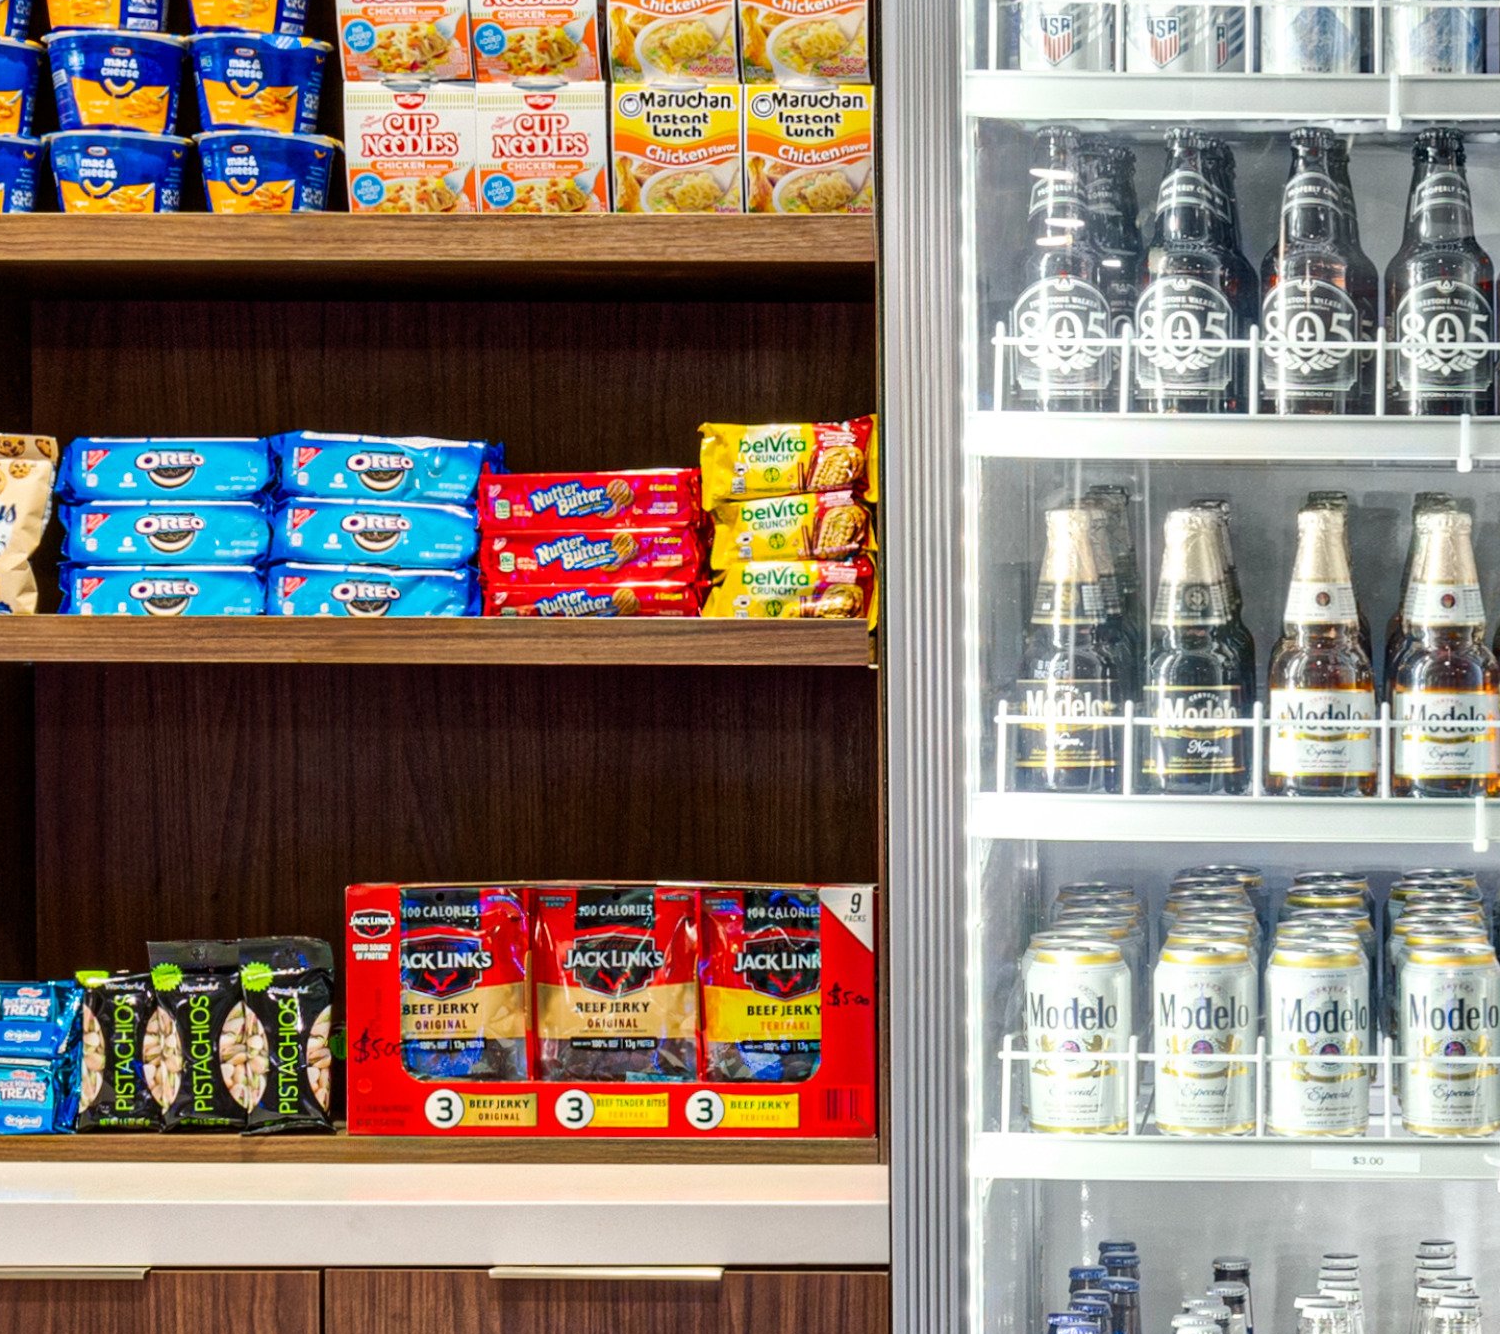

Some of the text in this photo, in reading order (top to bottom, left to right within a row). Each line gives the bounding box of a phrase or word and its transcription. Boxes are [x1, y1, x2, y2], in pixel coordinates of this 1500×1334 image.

[367, 7, 416, 16] CHICKEN
[1040, 17, 1072, 38] USA
[772, 92, 863, 108] Maruchan
[383, 114, 438, 134] CUP
[779, 112, 841, 124] Instant
[785, 125, 835, 138] Lunch
[362, 133, 458, 157] NOODLES
[1264, 312, 1353, 358] 805
[739, 432, 806, 454] belVita
[136, 451, 204, 471] OREO
[346, 453, 413, 473] OREO
[749, 453, 796, 463] CRUNCHY
[531, 483, 579, 511] Nutter
[558, 486, 604, 512] Butter
[598, 904, 653, 917] CALORIES
[850, 893, 862, 914] 9
[844, 915, 866, 923] PACKS
[564, 950, 664, 969] JACK LINK'S
[4, 1005, 48, 1018] TREATS
[576, 1002, 651, 1014] BEEF JERKY
[1281, 997, 1367, 1033] Modelo
[588, 1019, 638, 1030] ORIGINAL
[4, 1030, 41, 1042] Original
[193, 995, 213, 1112] PISTACHIOS
[278, 997, 298, 1114] PISTACHIOS
[436, 1097, 530, 1123] 3 BEEF JERKY
[1353, 1156, 1383, 1165] $3.00
